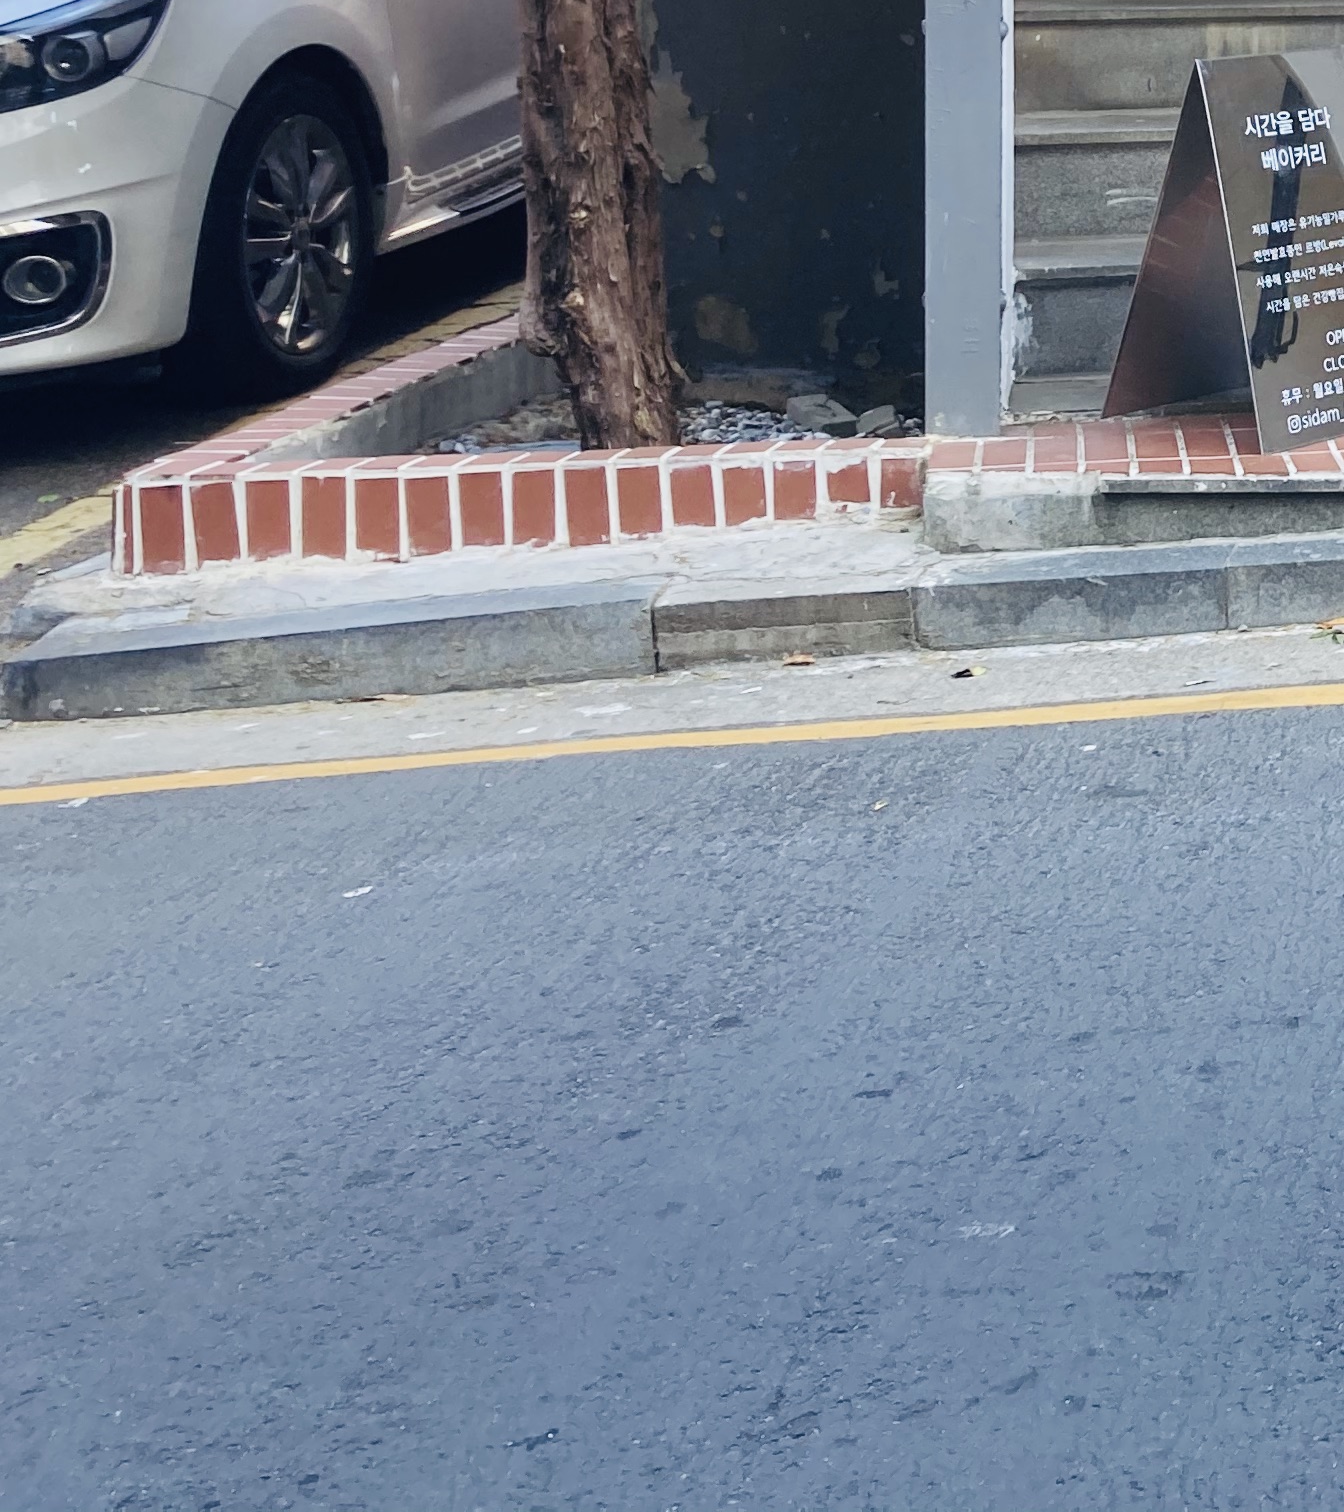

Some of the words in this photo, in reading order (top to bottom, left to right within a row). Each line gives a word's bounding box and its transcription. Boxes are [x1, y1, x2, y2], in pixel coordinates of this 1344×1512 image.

[1244, 111, 1294, 138] 시간을
[1297, 107, 1331, 132] 담다
[1261, 141, 1327, 171] 베이커리
[1281, 387, 1303, 406] 휴무
